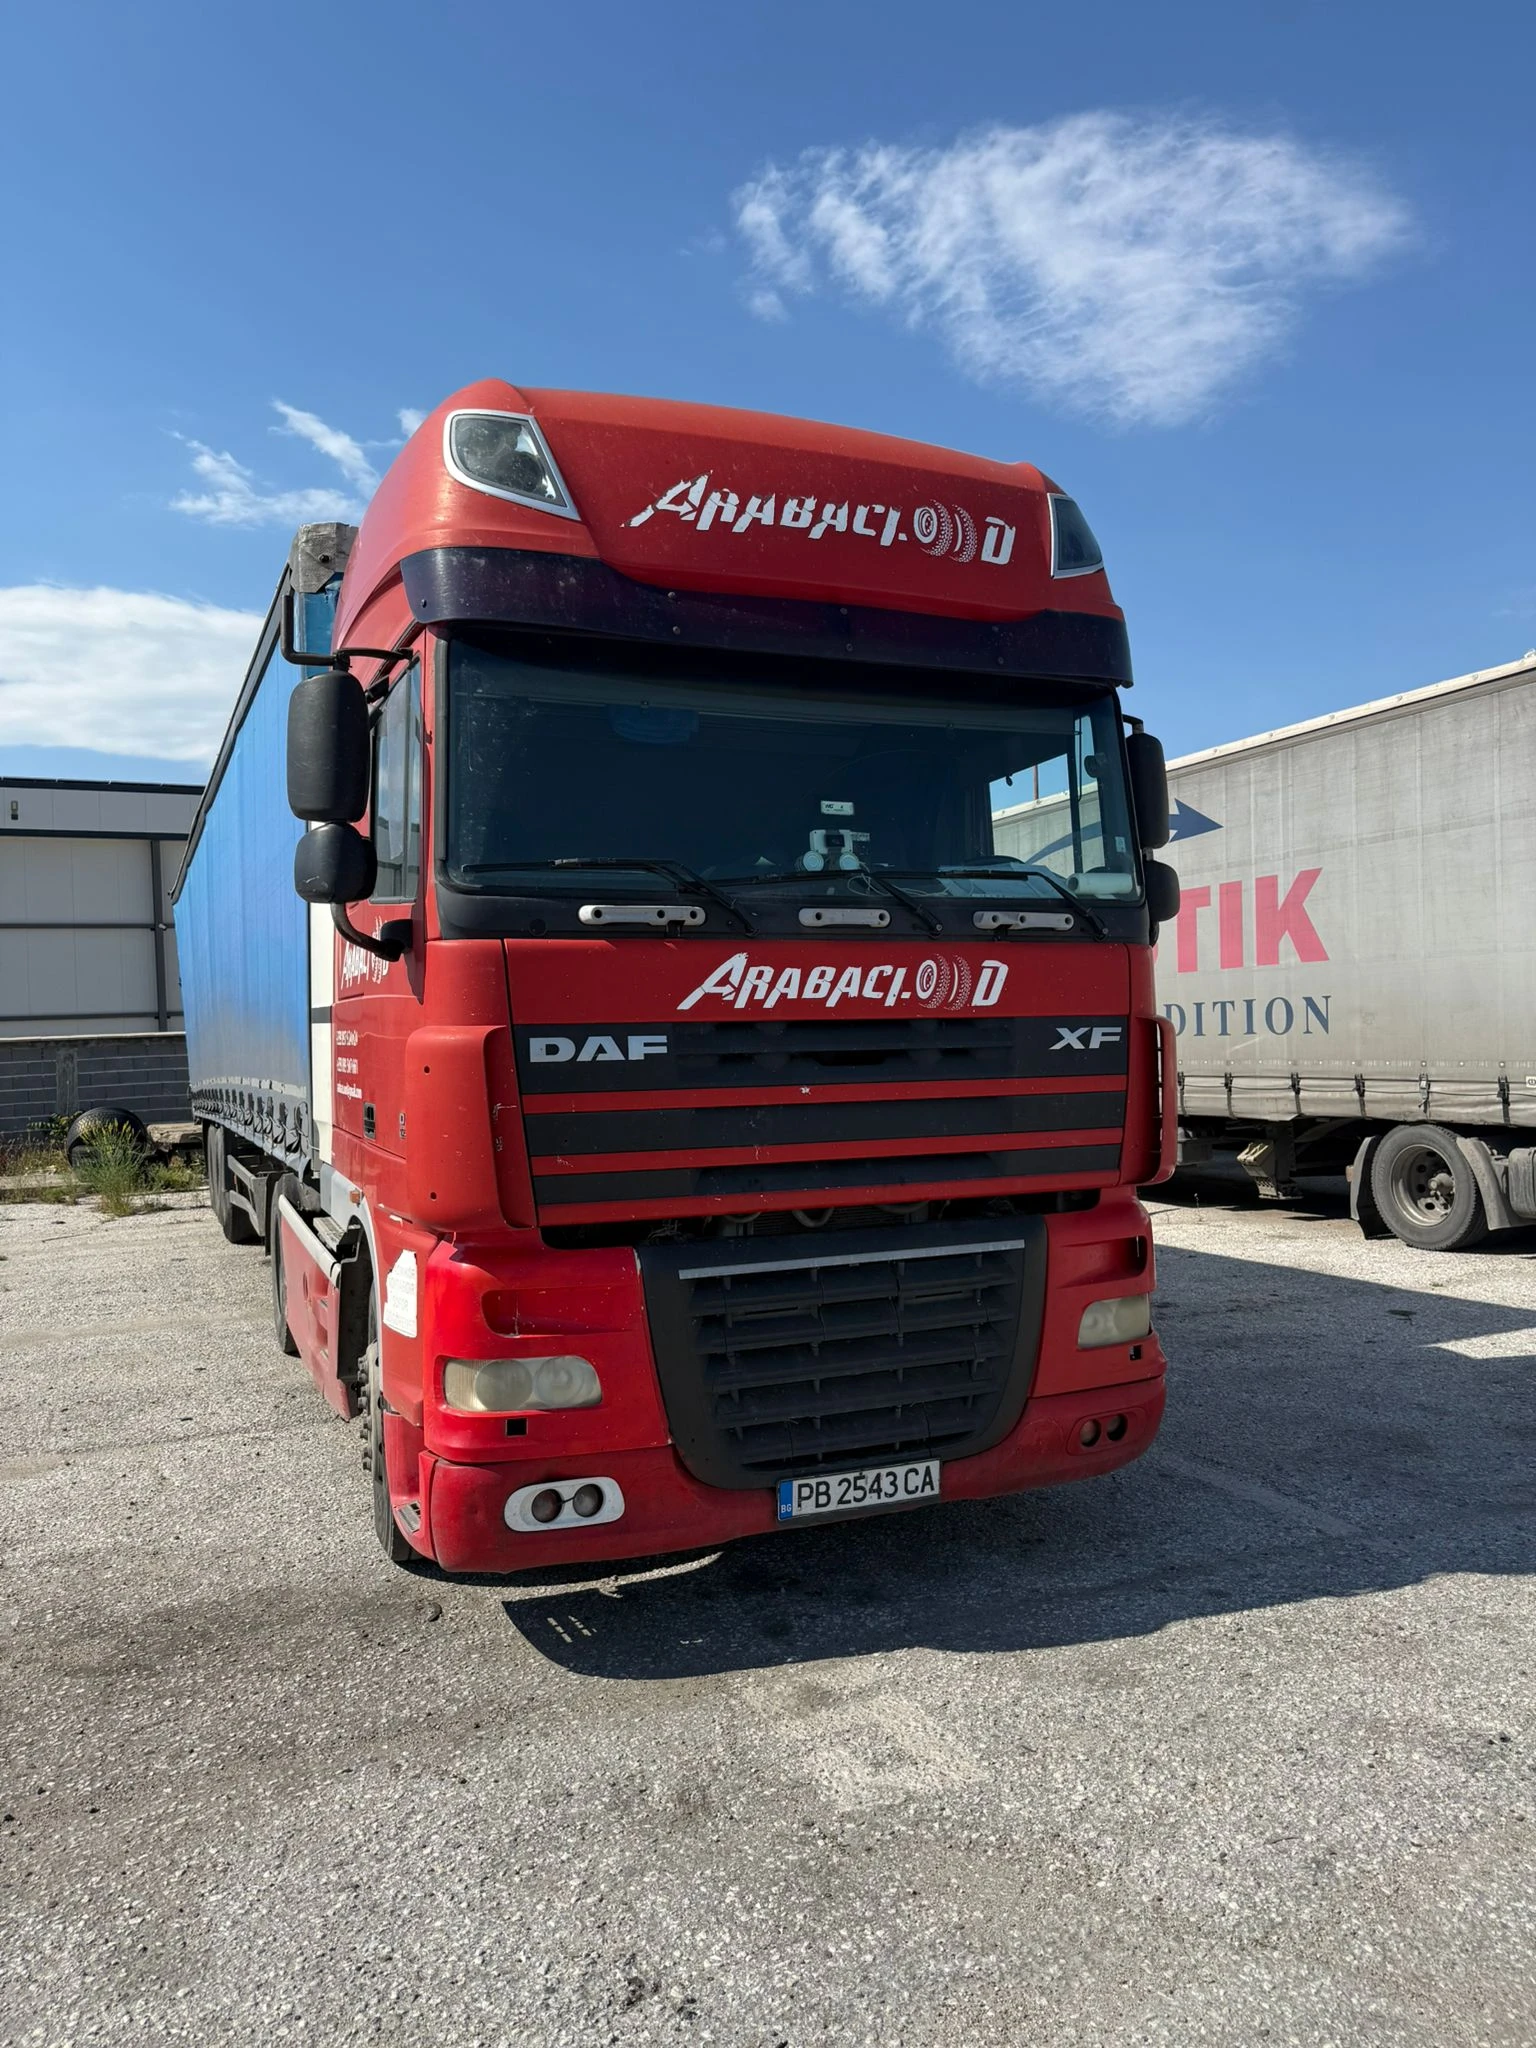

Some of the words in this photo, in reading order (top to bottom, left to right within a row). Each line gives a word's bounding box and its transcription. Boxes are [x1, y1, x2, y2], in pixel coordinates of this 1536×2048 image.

[1153, 867, 1330, 974] TIK
[529, 1035, 668, 1063] DAF
[1049, 1026, 1122, 1050] XF
[797, 1481, 831, 1511] PB
[837, 1470, 899, 1505] 2543
[904, 1465, 935, 1496] CA
[780, 1503, 792, 1514] BG
